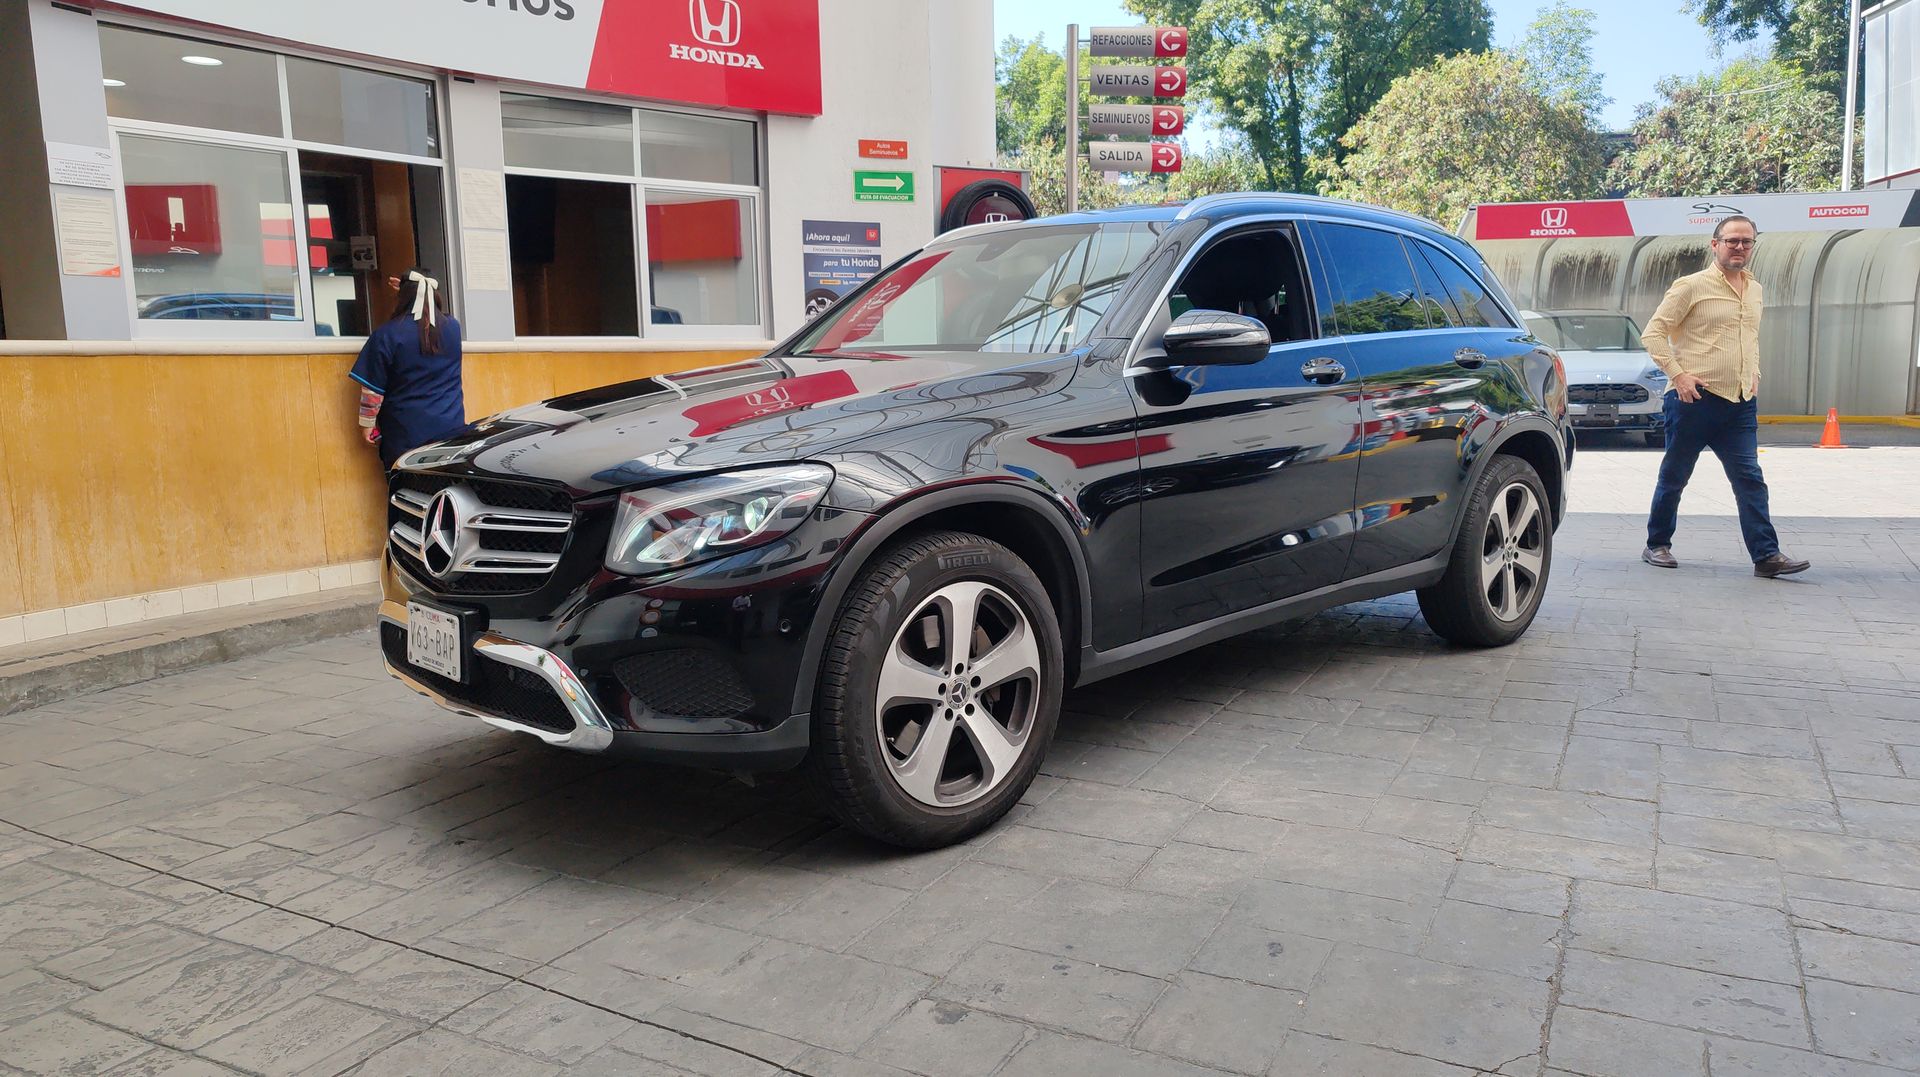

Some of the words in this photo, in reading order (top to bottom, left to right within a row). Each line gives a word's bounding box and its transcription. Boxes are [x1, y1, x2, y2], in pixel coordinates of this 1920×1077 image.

[1092, 35, 1153, 46] REFACCIONES
[669, 43, 765, 70] HONDA
[1096, 74, 1150, 86] VENTAS
[1092, 112, 1151, 124] SEMINUEVOS
[869, 148, 898, 156] Seminuevos
[1099, 150, 1143, 161] SALIDA
[1811, 206, 1868, 217] AUTOCOM
[1529, 228, 1577, 236] HONDA
[823, 260, 839, 268] para
[841, 257, 850, 267] tu
[851, 257, 879, 267] Honda
[410, 619, 455, 661] V63-BAP
